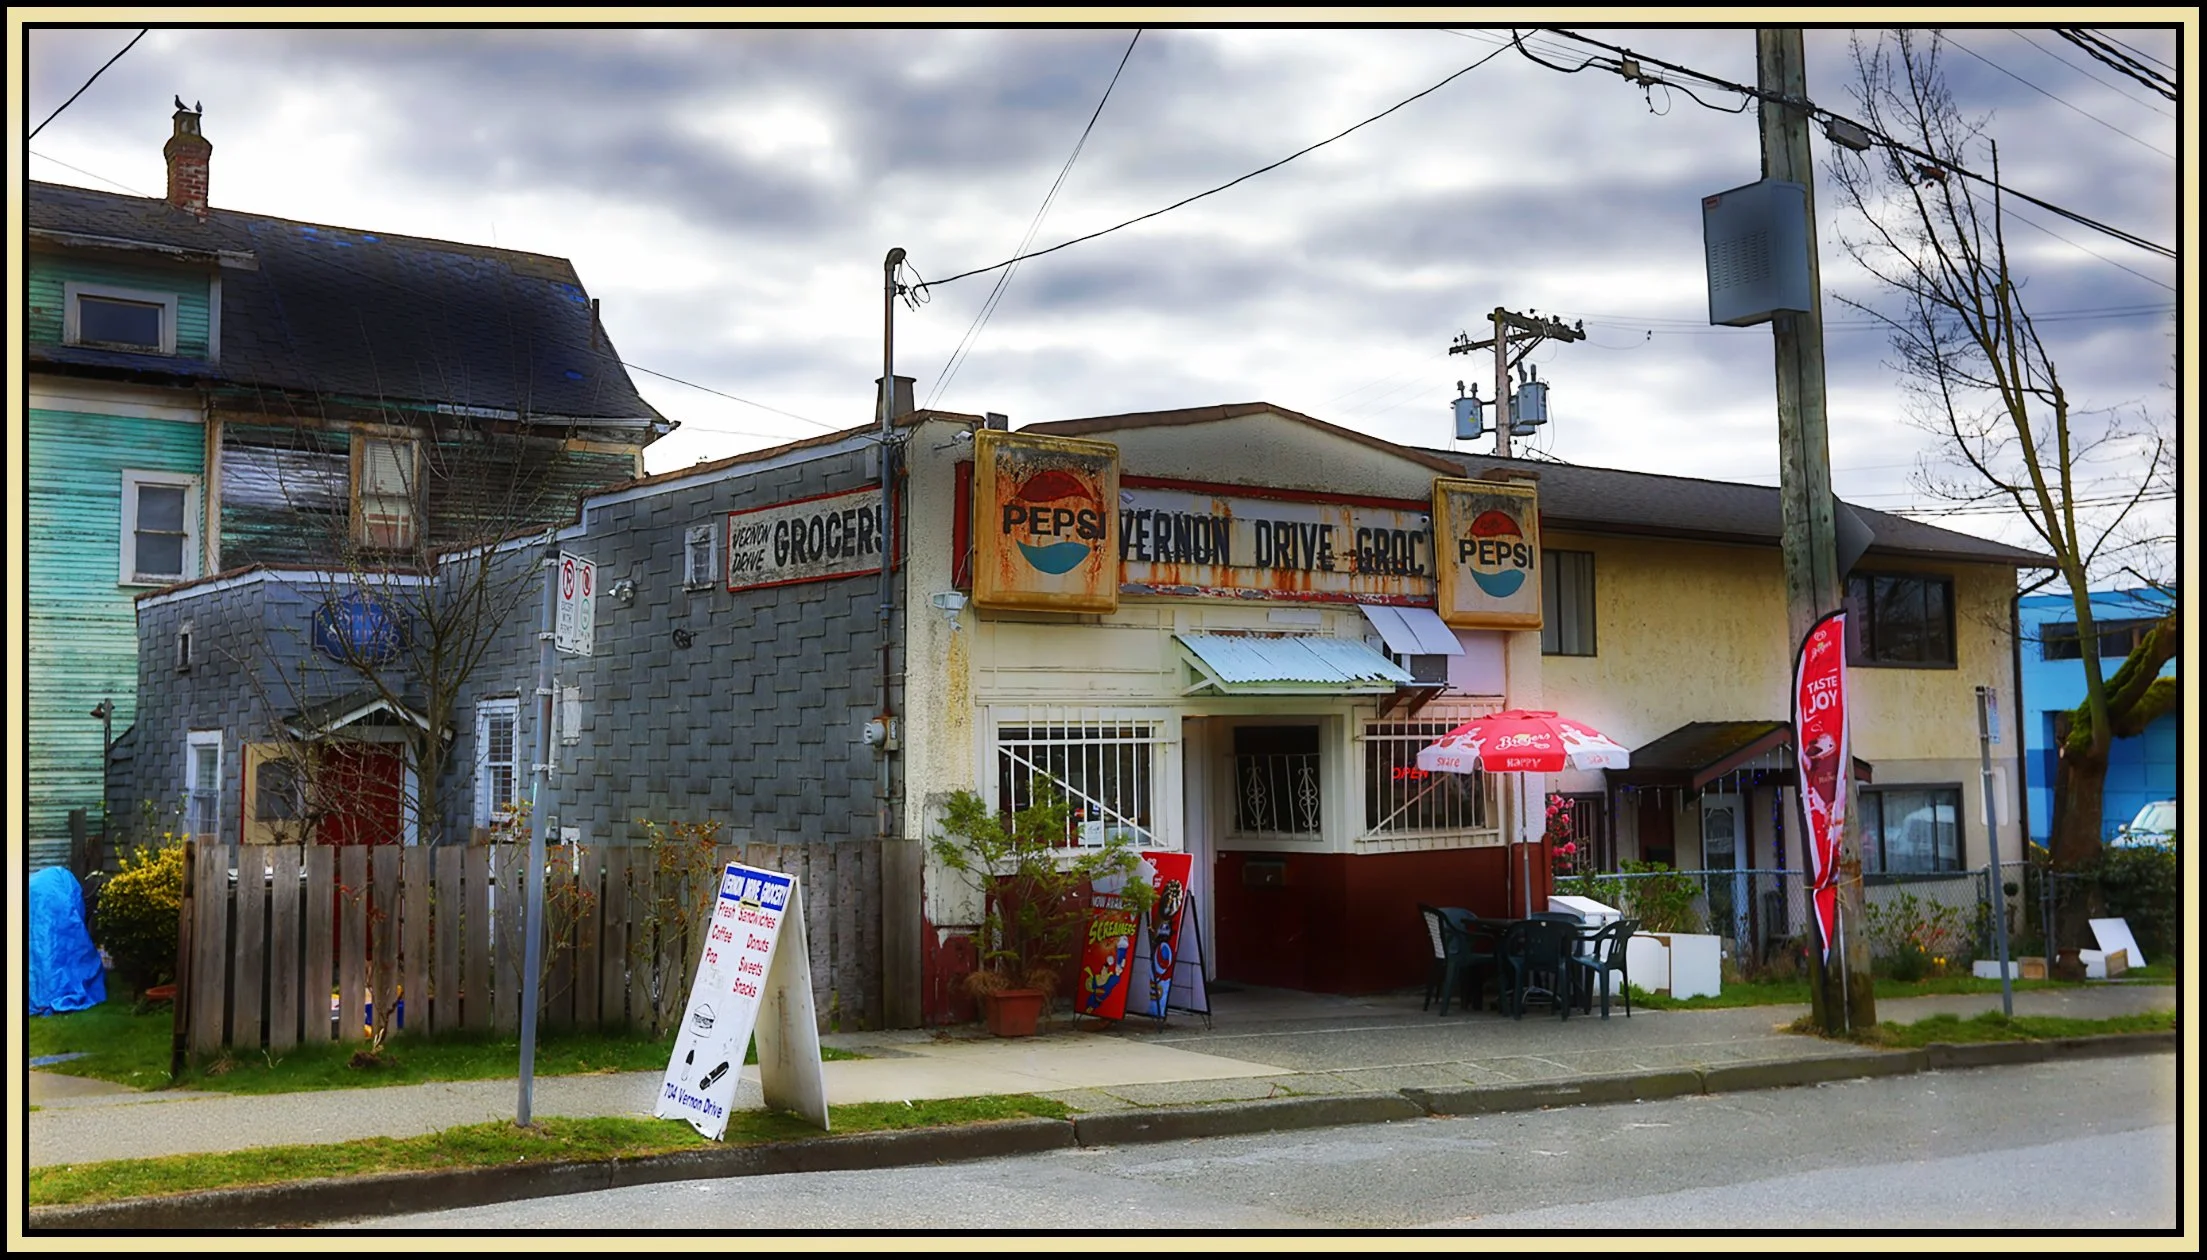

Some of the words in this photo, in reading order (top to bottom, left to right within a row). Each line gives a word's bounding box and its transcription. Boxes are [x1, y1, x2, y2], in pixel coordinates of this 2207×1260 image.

[1003, 505, 1106, 540] PEPSI
[732, 523, 772, 549] VERNON
[1119, 509, 1230, 566] VERNON
[1256, 519, 1335, 572] DRIVE
[732, 549, 765, 573] DRIVE
[1459, 539, 1534, 569] PEPSI
[1807, 675, 1838, 695] TASTE
[1808, 690, 1838, 714] JOY
[1393, 767, 1429, 780] OPEN
[717, 901, 736, 920] Fresh
[738, 908, 776, 930] Sandwiches
[711, 924, 733, 943] Coffee
[746, 933, 769, 953] Donuts
[1089, 920, 1136, 945] SCREAMERS
[705, 947, 718, 965] Pop
[738, 956, 764, 977] Sweets
[732, 977, 758, 998] Snacks
[664, 1082, 677, 1101] 704
[678, 1088, 703, 1112] Vernon
[703, 1097, 723, 1119] Drive
